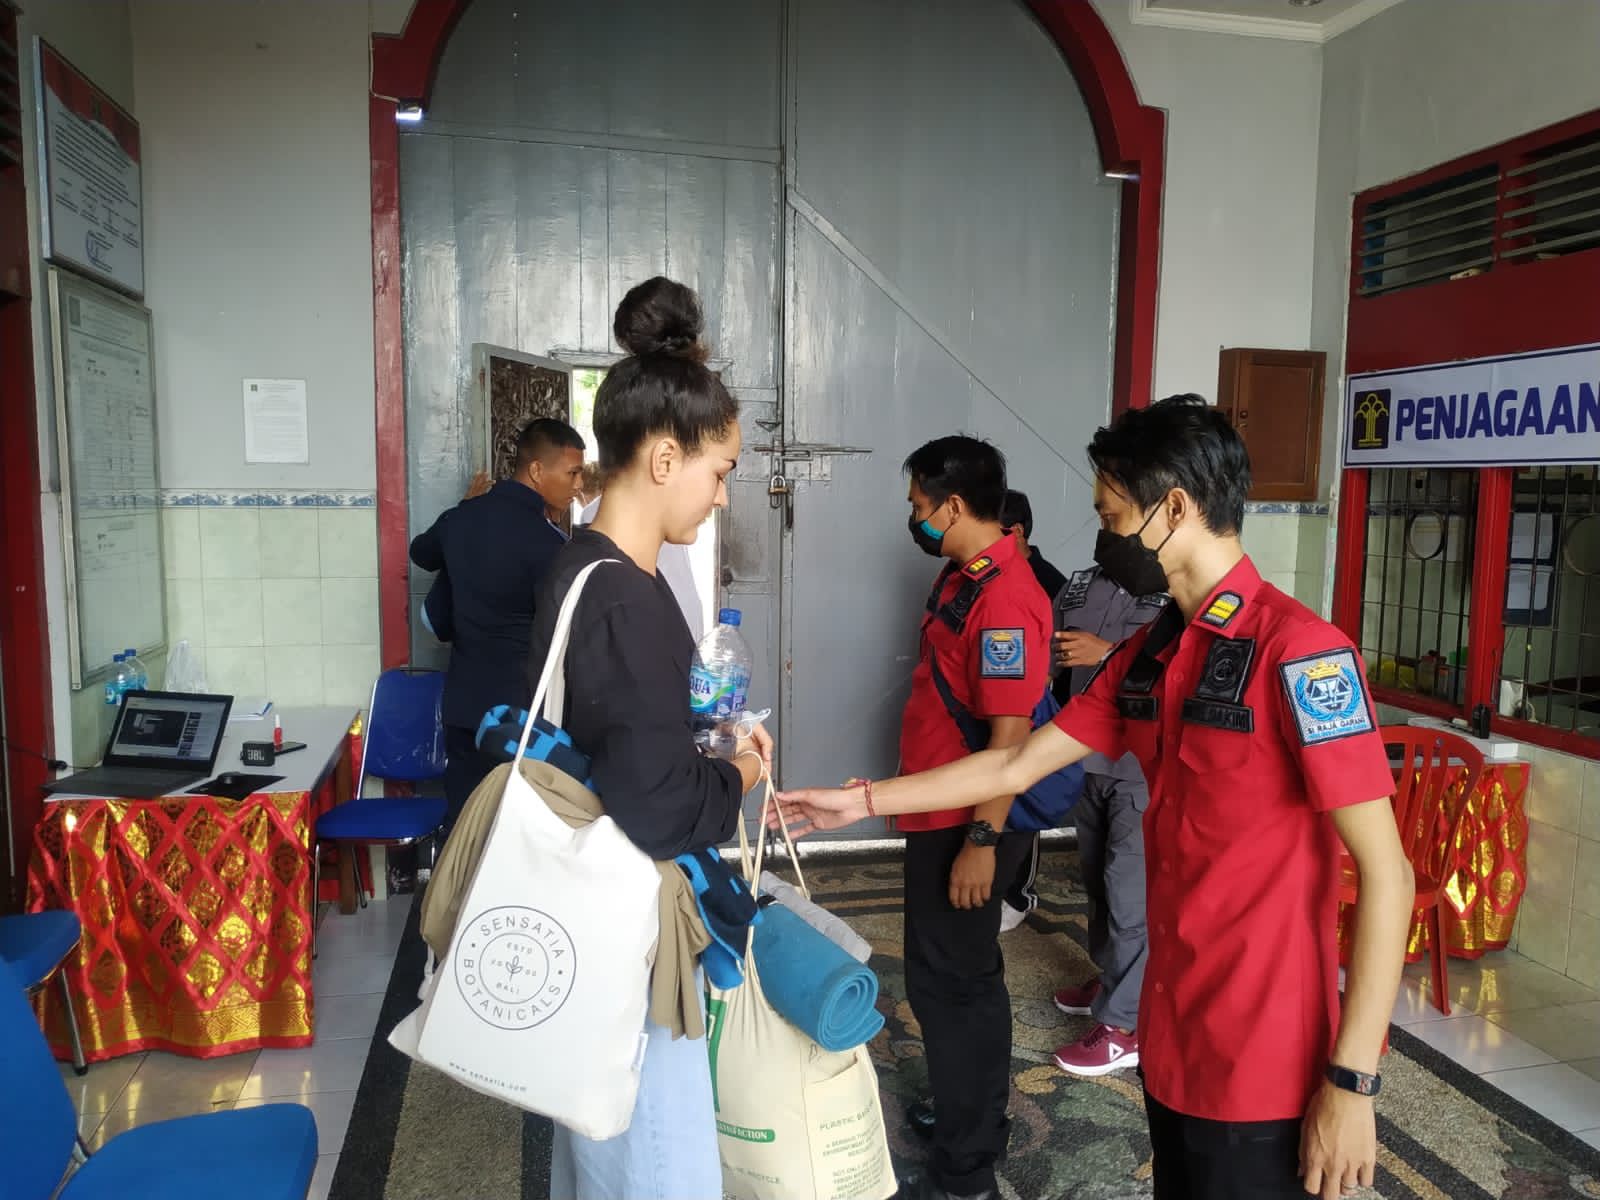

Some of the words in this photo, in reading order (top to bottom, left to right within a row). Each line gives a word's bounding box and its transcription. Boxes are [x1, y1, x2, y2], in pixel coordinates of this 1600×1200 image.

[1395, 382, 1600, 441] PENJAGAAN
[1317, 722, 1337, 731] RAJA
[247, 749, 265, 761] JBL
[480, 915, 565, 959] SENSATIA
[463, 958, 562, 1021] BOTANICALS
